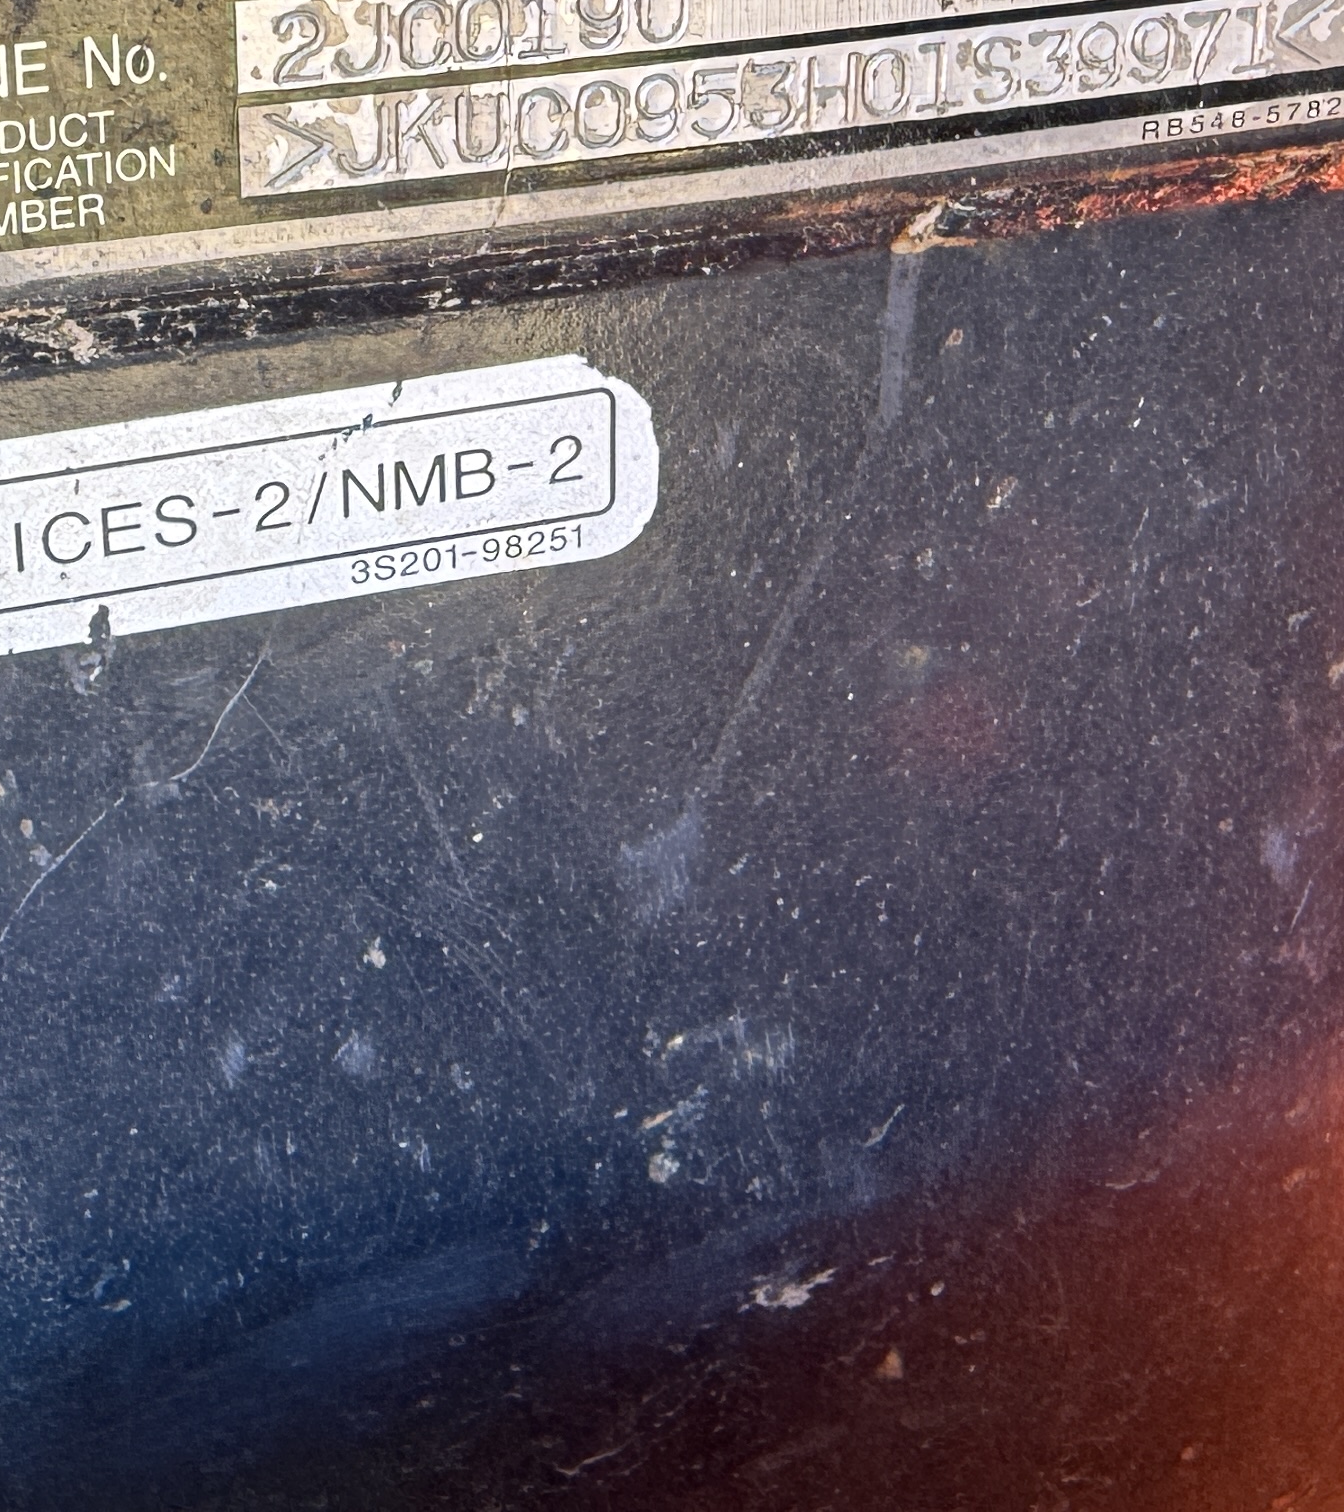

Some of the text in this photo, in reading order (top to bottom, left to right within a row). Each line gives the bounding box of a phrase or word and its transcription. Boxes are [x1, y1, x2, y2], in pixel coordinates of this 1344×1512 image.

[83, 34, 169, 89] No.
[13, 434, 586, 573] ICES-2/NMB-2
[349, 523, 585, 587] 3S201-98251
